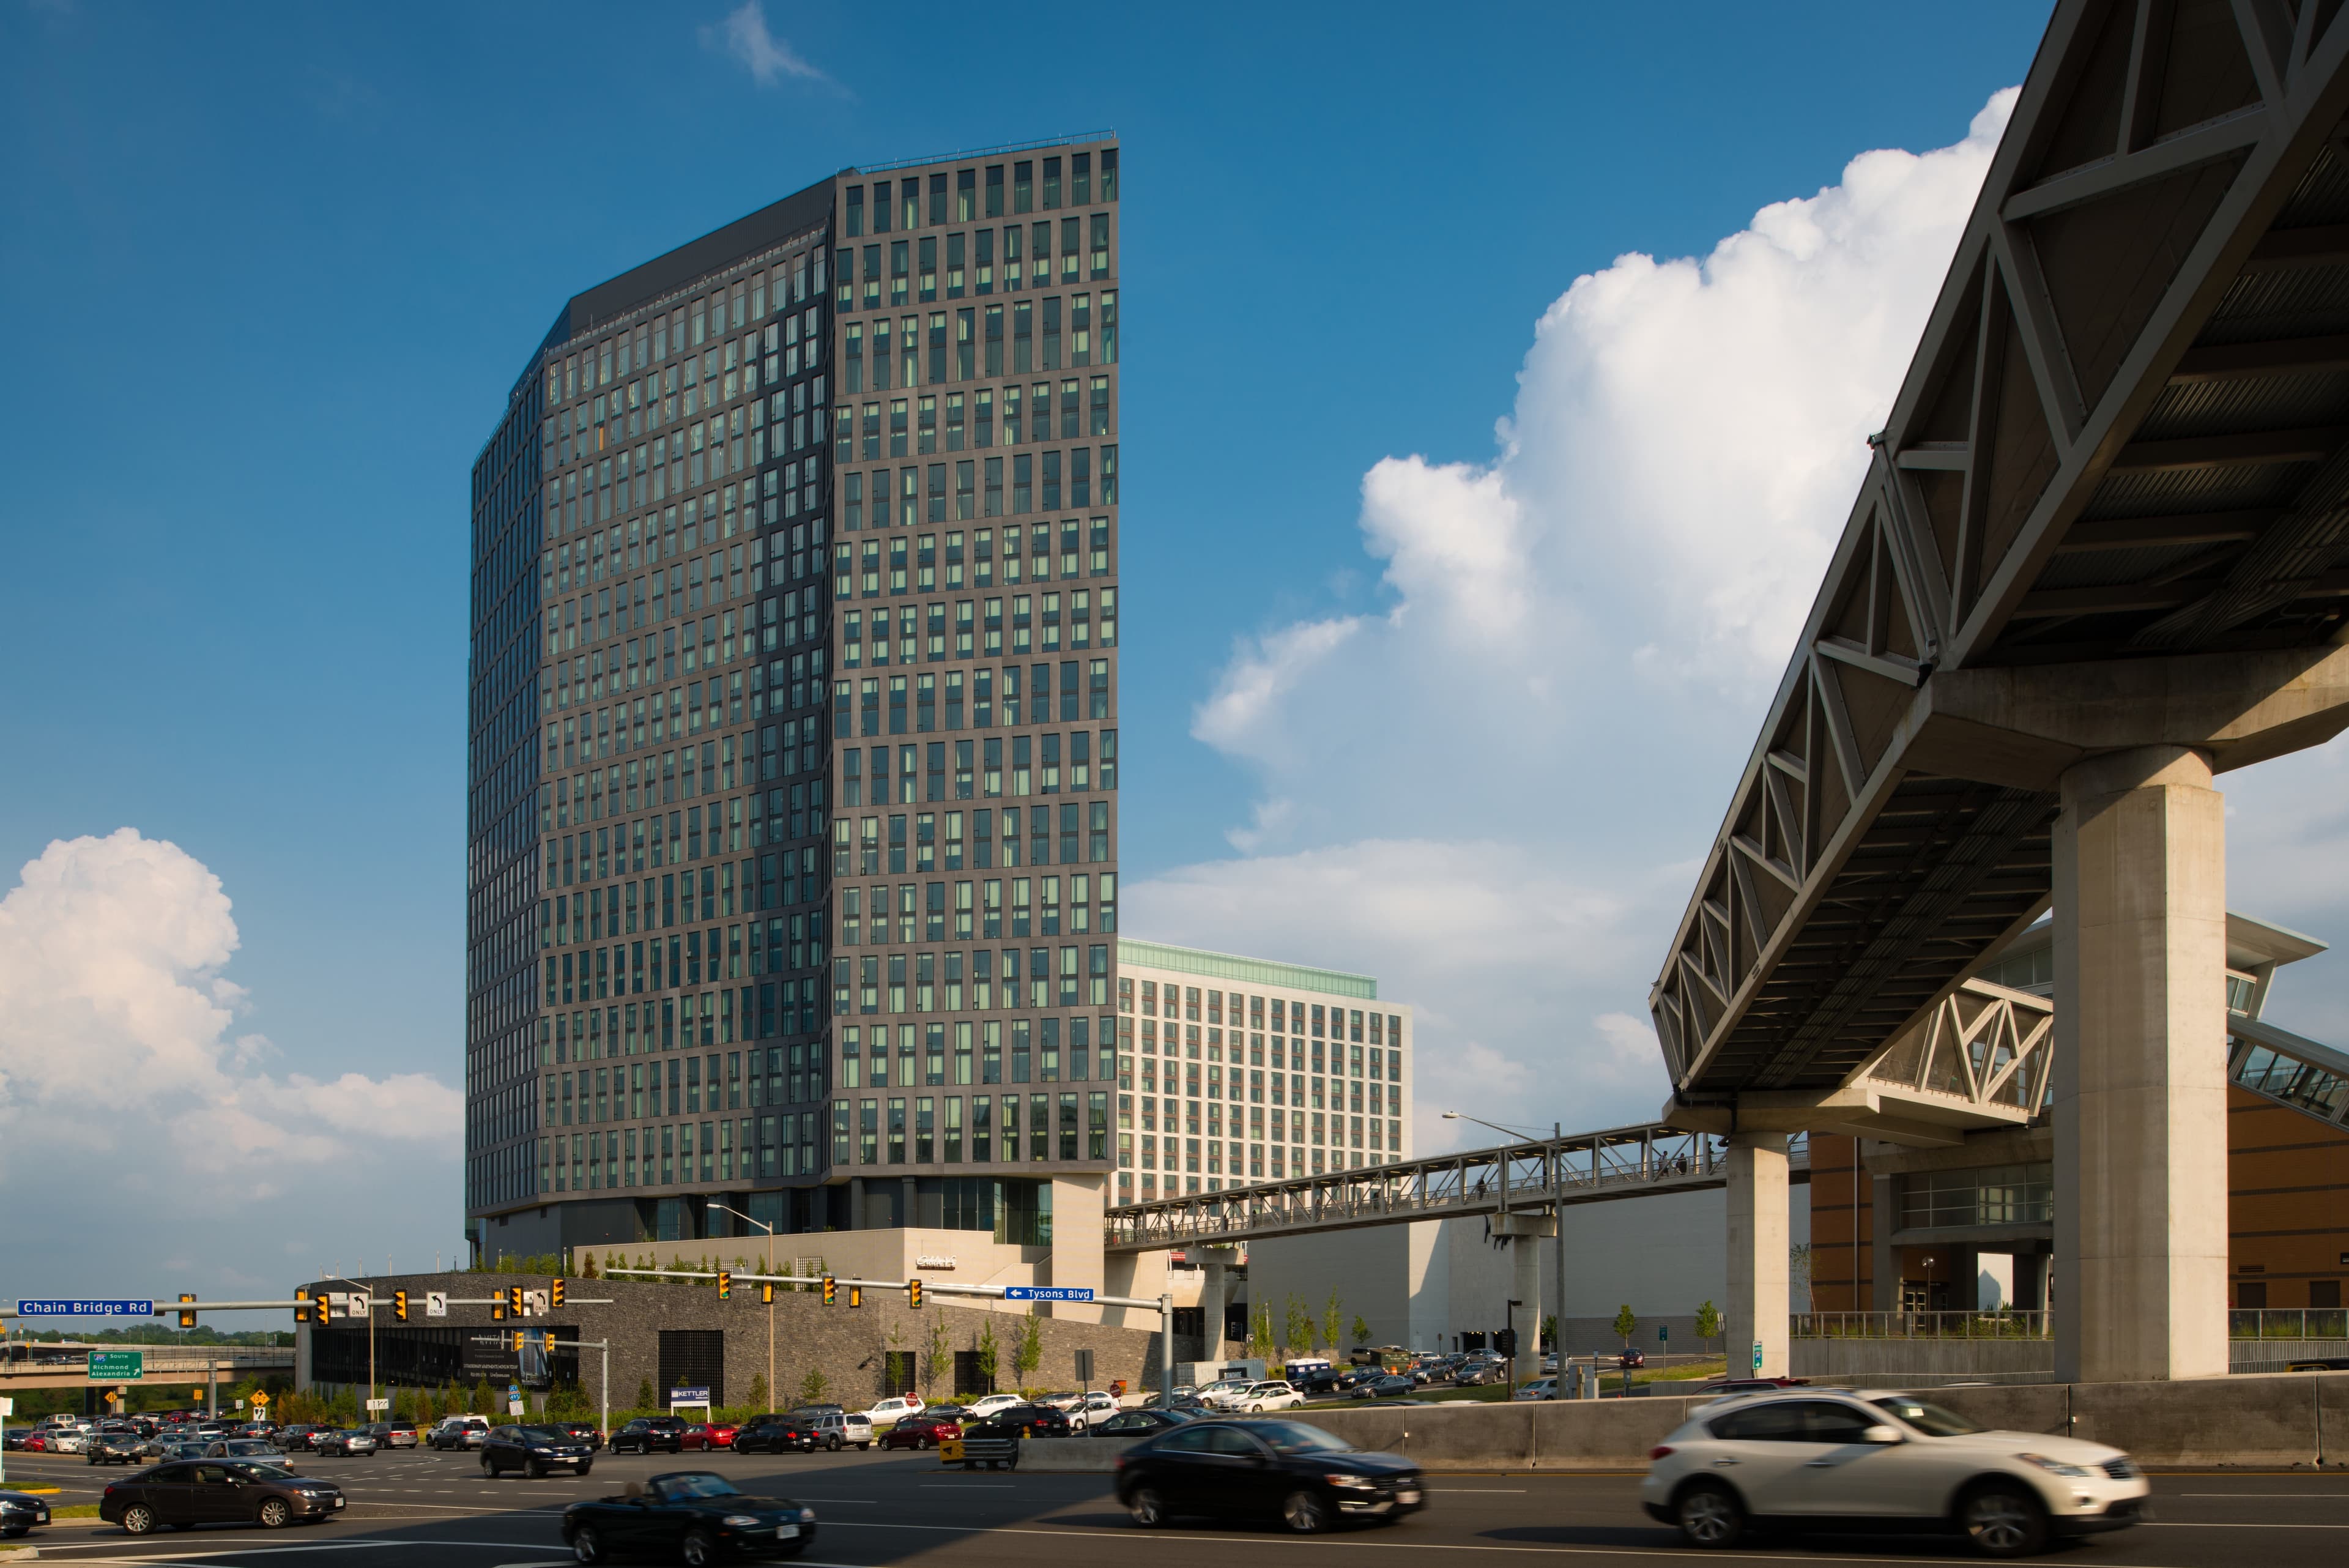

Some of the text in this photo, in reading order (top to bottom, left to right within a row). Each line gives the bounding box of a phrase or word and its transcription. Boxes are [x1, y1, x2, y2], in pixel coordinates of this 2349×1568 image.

[1028, 1289, 1063, 1299] Tysons
[24, 1302, 147, 1315] Chain Bridge Rd
